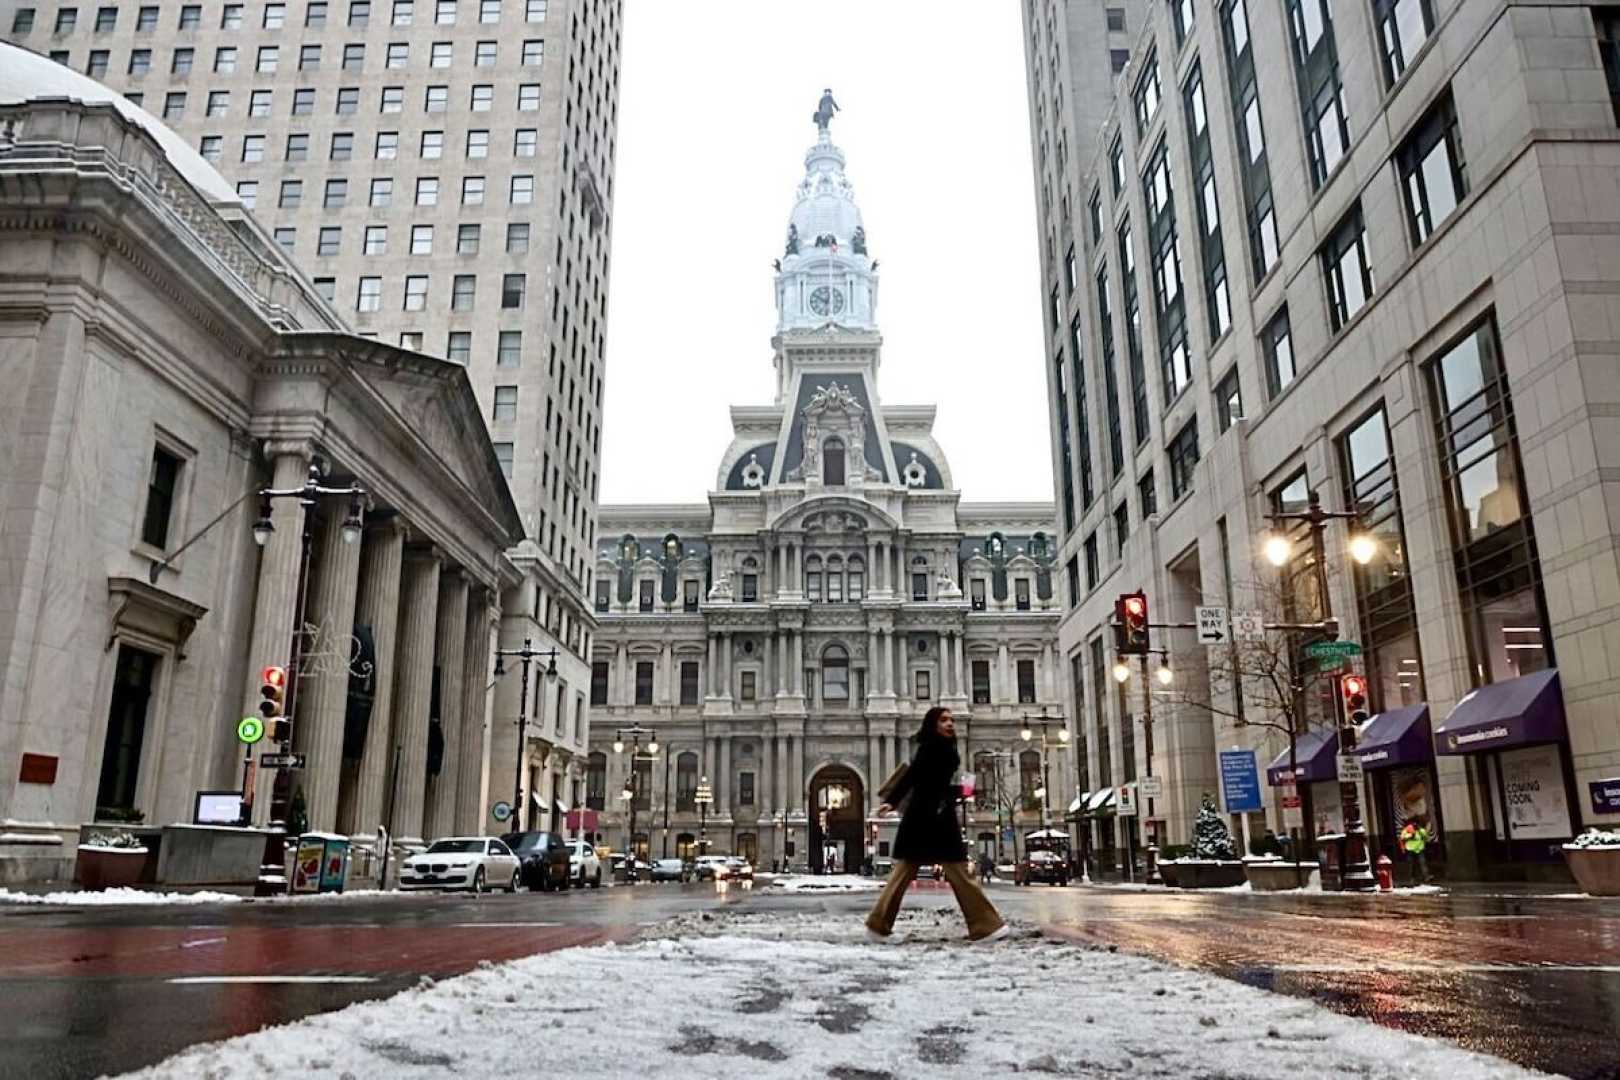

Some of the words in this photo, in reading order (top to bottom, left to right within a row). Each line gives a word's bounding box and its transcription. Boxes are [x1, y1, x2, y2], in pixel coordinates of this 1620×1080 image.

[1201, 609, 1220, 618] ONE
[1201, 620, 1221, 629] WAY
[1506, 781, 1540, 793] COMING
[1508, 793, 1532, 805] SOON
